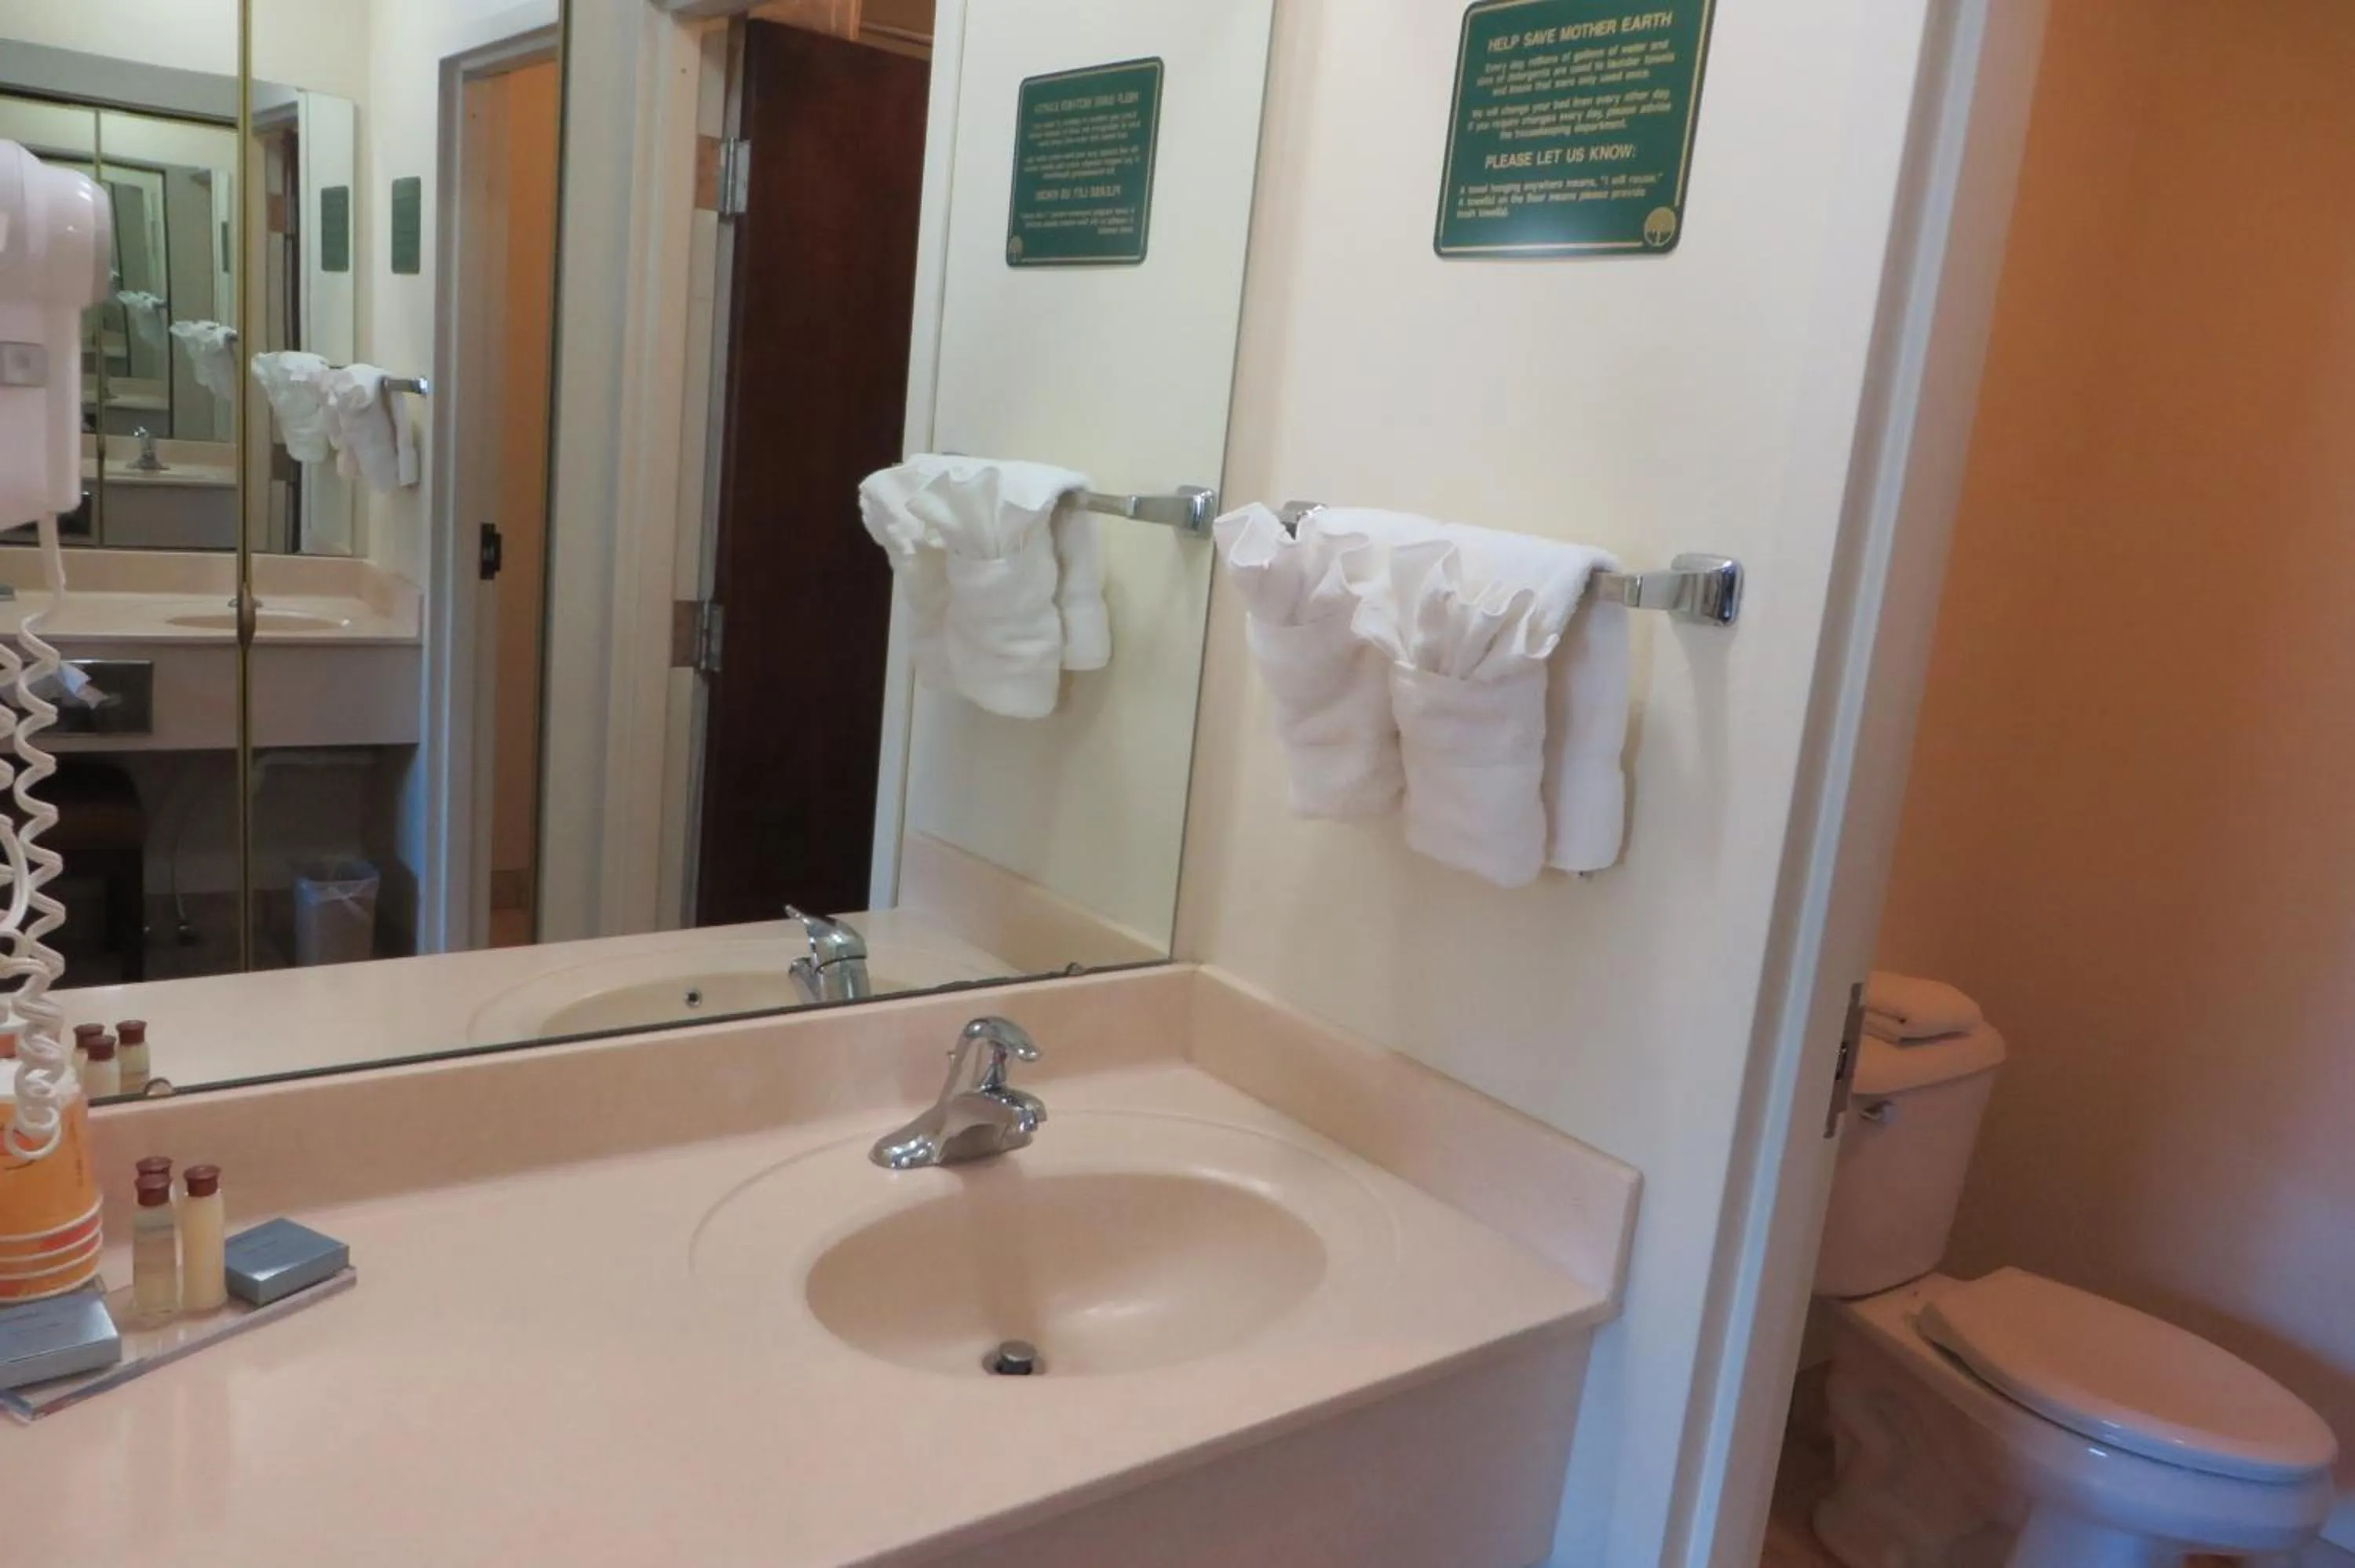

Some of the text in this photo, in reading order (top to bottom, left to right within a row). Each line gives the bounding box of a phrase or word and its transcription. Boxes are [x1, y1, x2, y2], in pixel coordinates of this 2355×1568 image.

[1487, 11, 1674, 53] HELP SAVE MOTHER EARTH
[1484, 151, 1533, 170] PLEASE
[1536, 148, 1563, 166] LET
[1566, 146, 1585, 163] US
